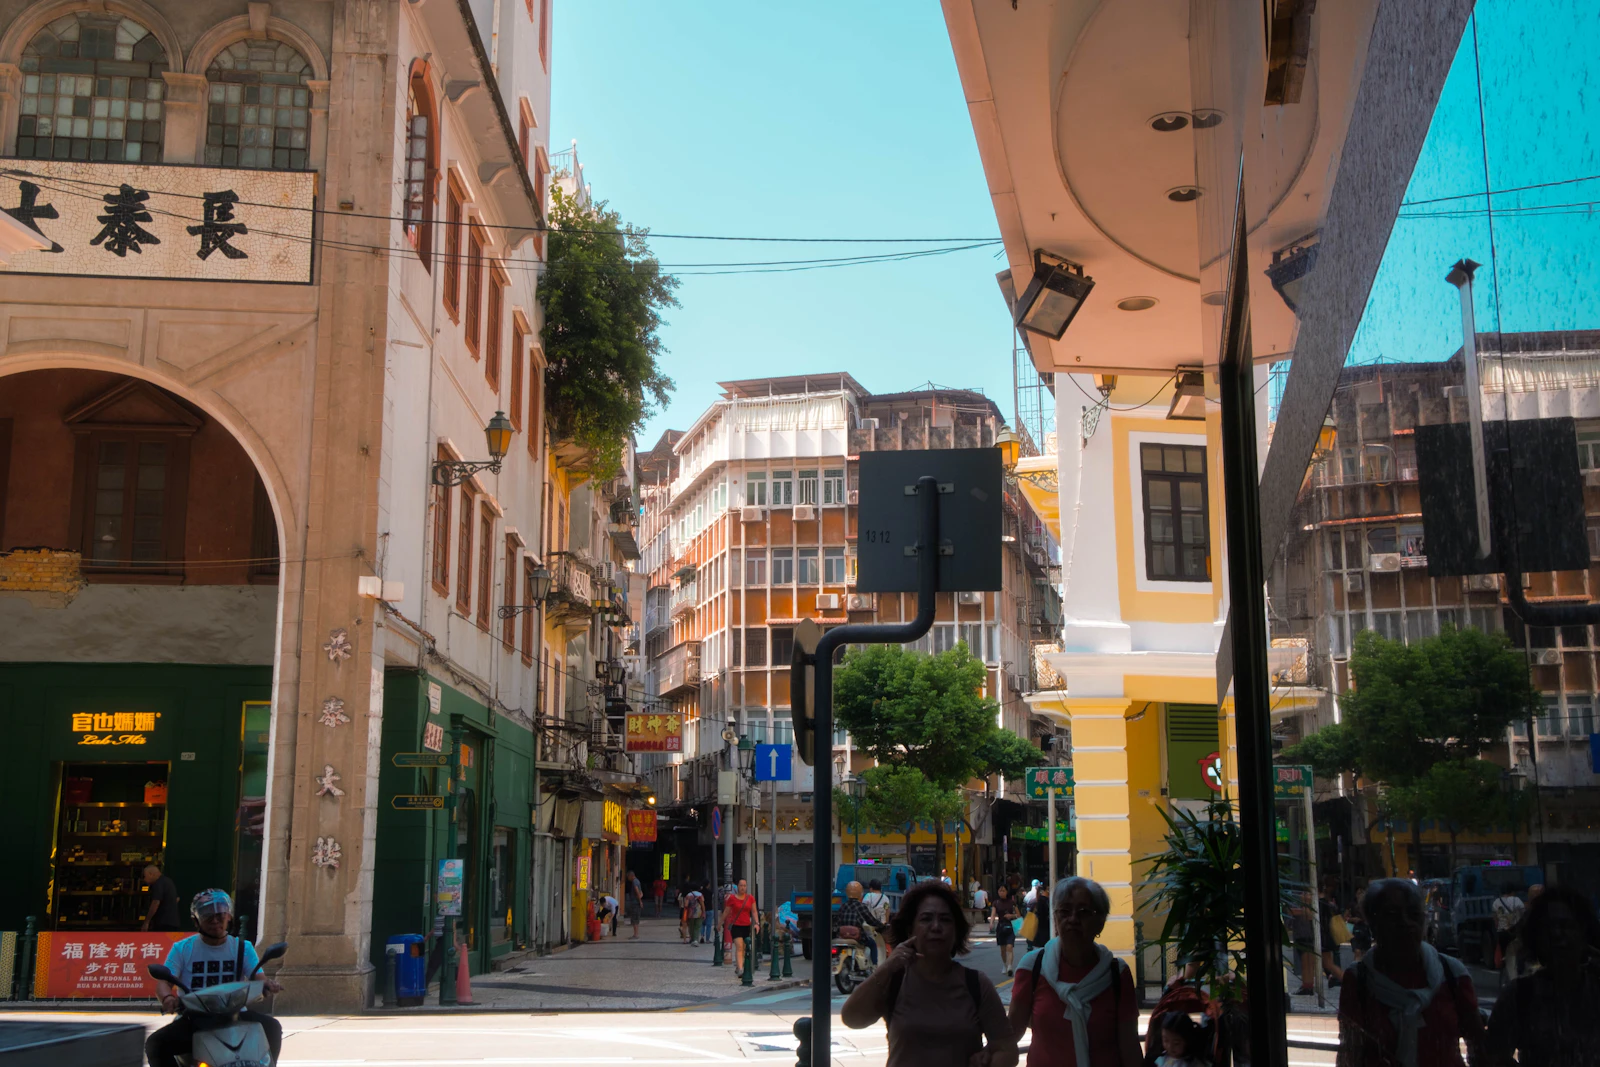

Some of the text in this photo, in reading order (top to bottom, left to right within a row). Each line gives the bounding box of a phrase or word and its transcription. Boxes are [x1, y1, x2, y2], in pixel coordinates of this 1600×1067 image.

[1034, 769, 1074, 785] 順德
[61, 941, 164, 960] 福隆新街
[85, 962, 137, 974] 步行區
